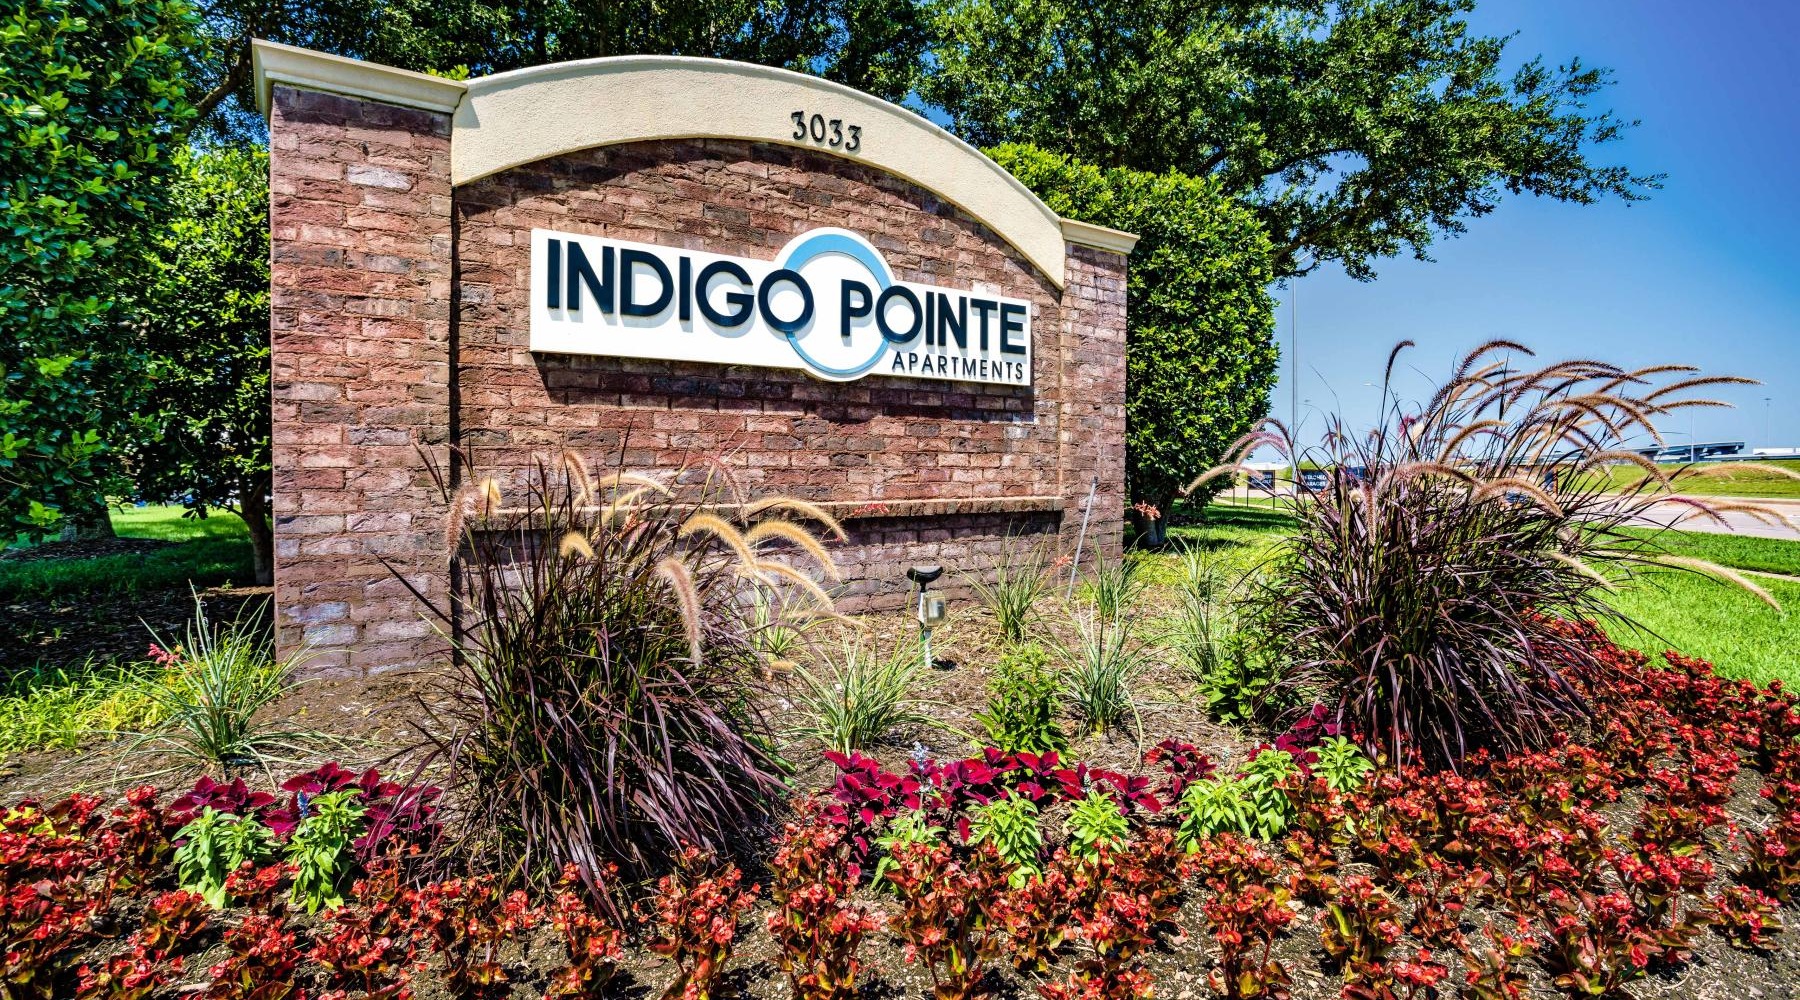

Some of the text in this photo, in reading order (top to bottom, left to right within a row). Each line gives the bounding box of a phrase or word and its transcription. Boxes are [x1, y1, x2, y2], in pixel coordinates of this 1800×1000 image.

[791, 111, 861, 151] 3033
[547, 238, 1027, 355] INDIGO POINTE
[891, 351, 1023, 380] APARTMENTS
